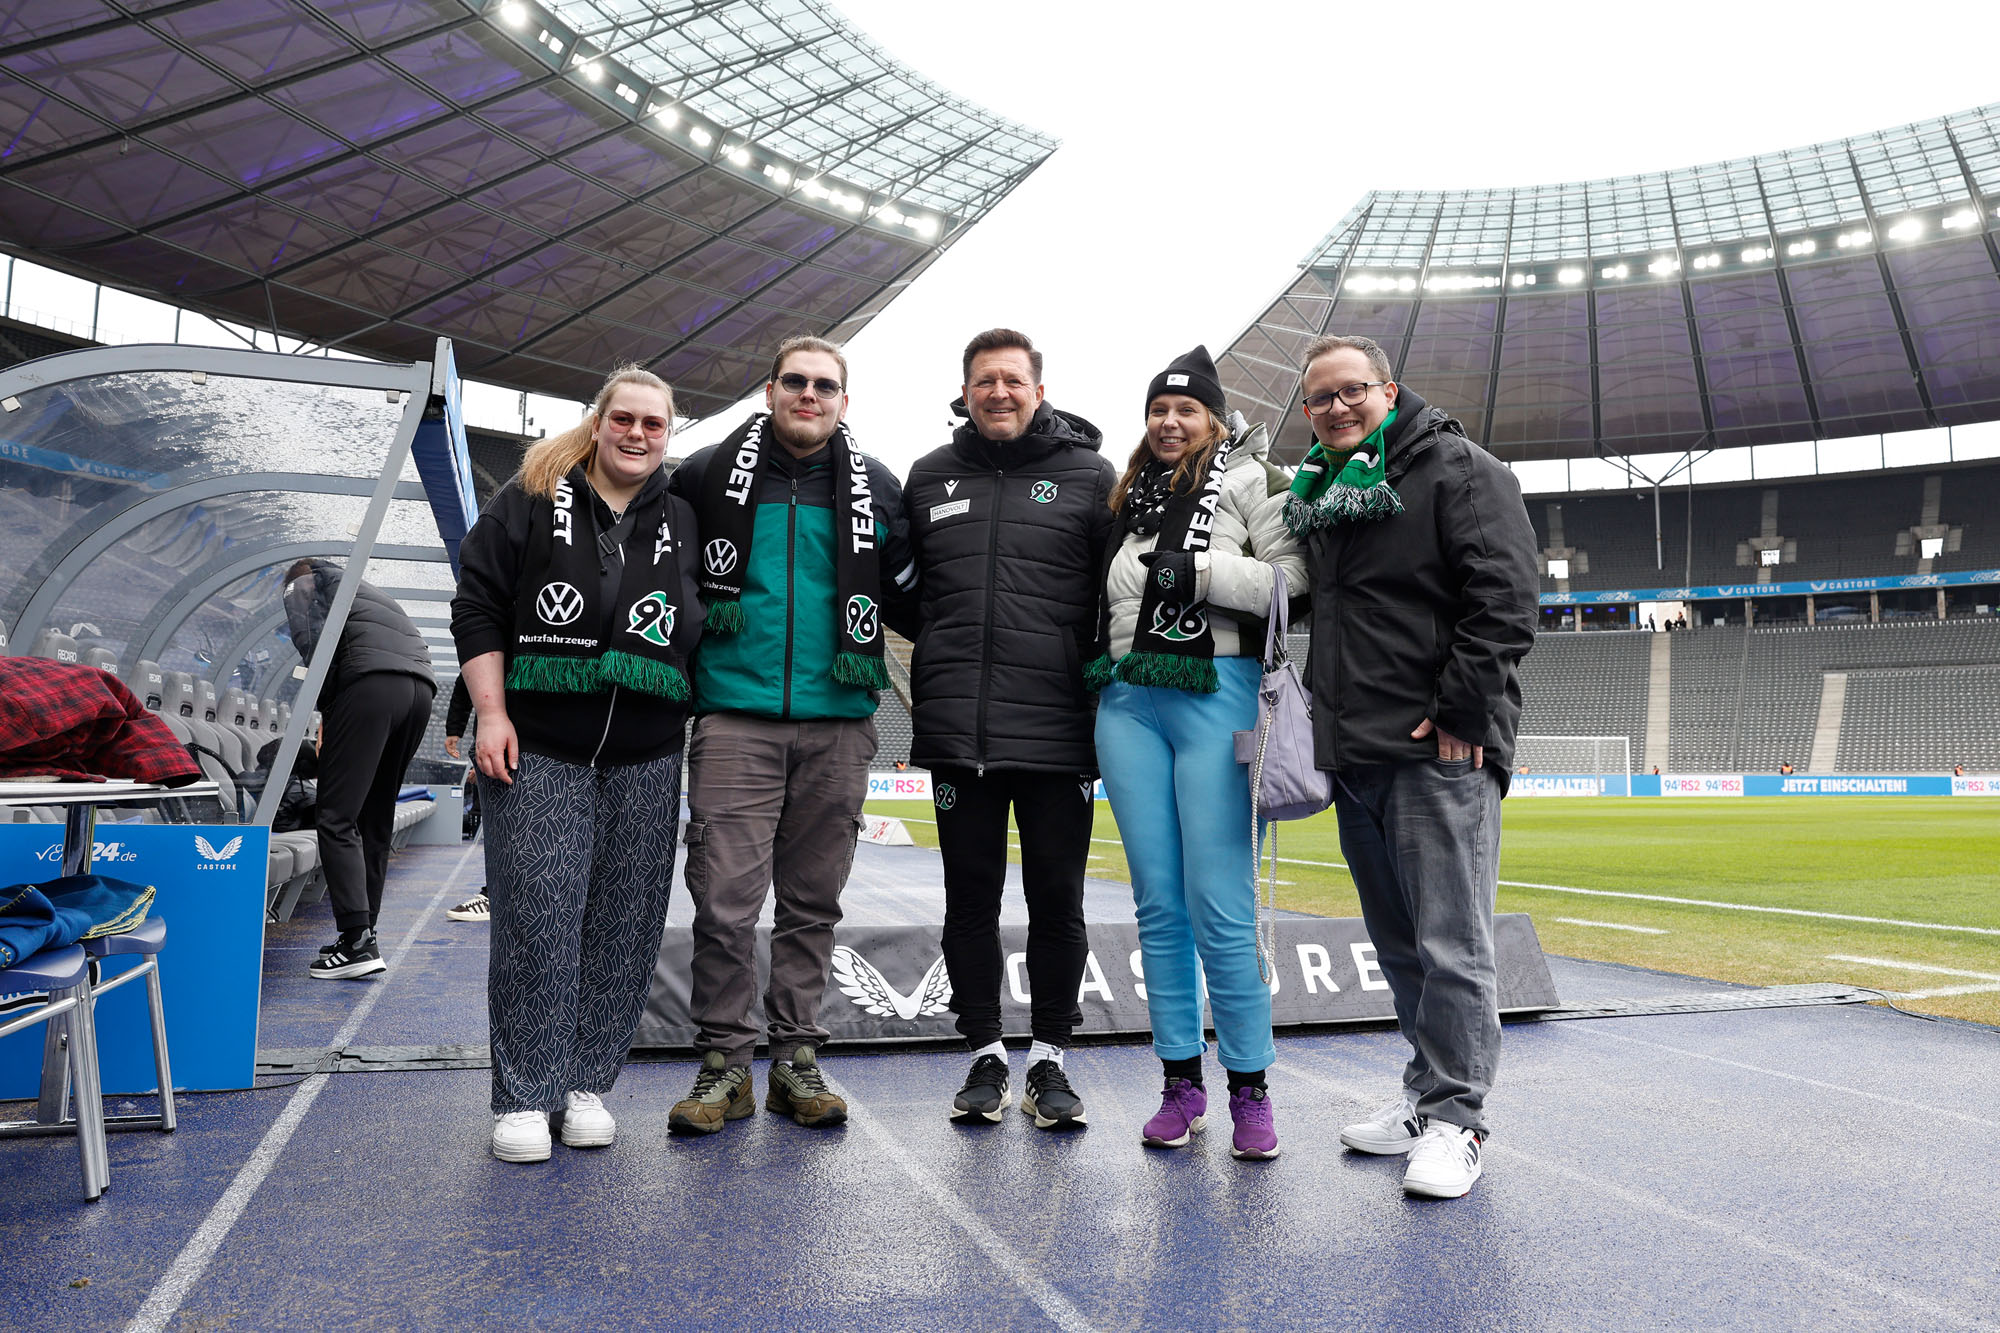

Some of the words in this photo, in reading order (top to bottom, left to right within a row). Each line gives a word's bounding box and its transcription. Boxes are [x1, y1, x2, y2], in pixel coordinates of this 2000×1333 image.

[1029, 482, 1060, 503] 96
[1735, 585, 1781, 594] CASTORE
[1828, 580, 1877, 589] CASTORE
[847, 601, 878, 638] 96
[1149, 601, 1208, 634] 96
[519, 633, 598, 648] Nutzfahrzeuge
[1780, 779, 1819, 793] JETZT
[1820, 778, 1908, 793] EINSCHALTEN!
[936, 785, 956, 807] 96
